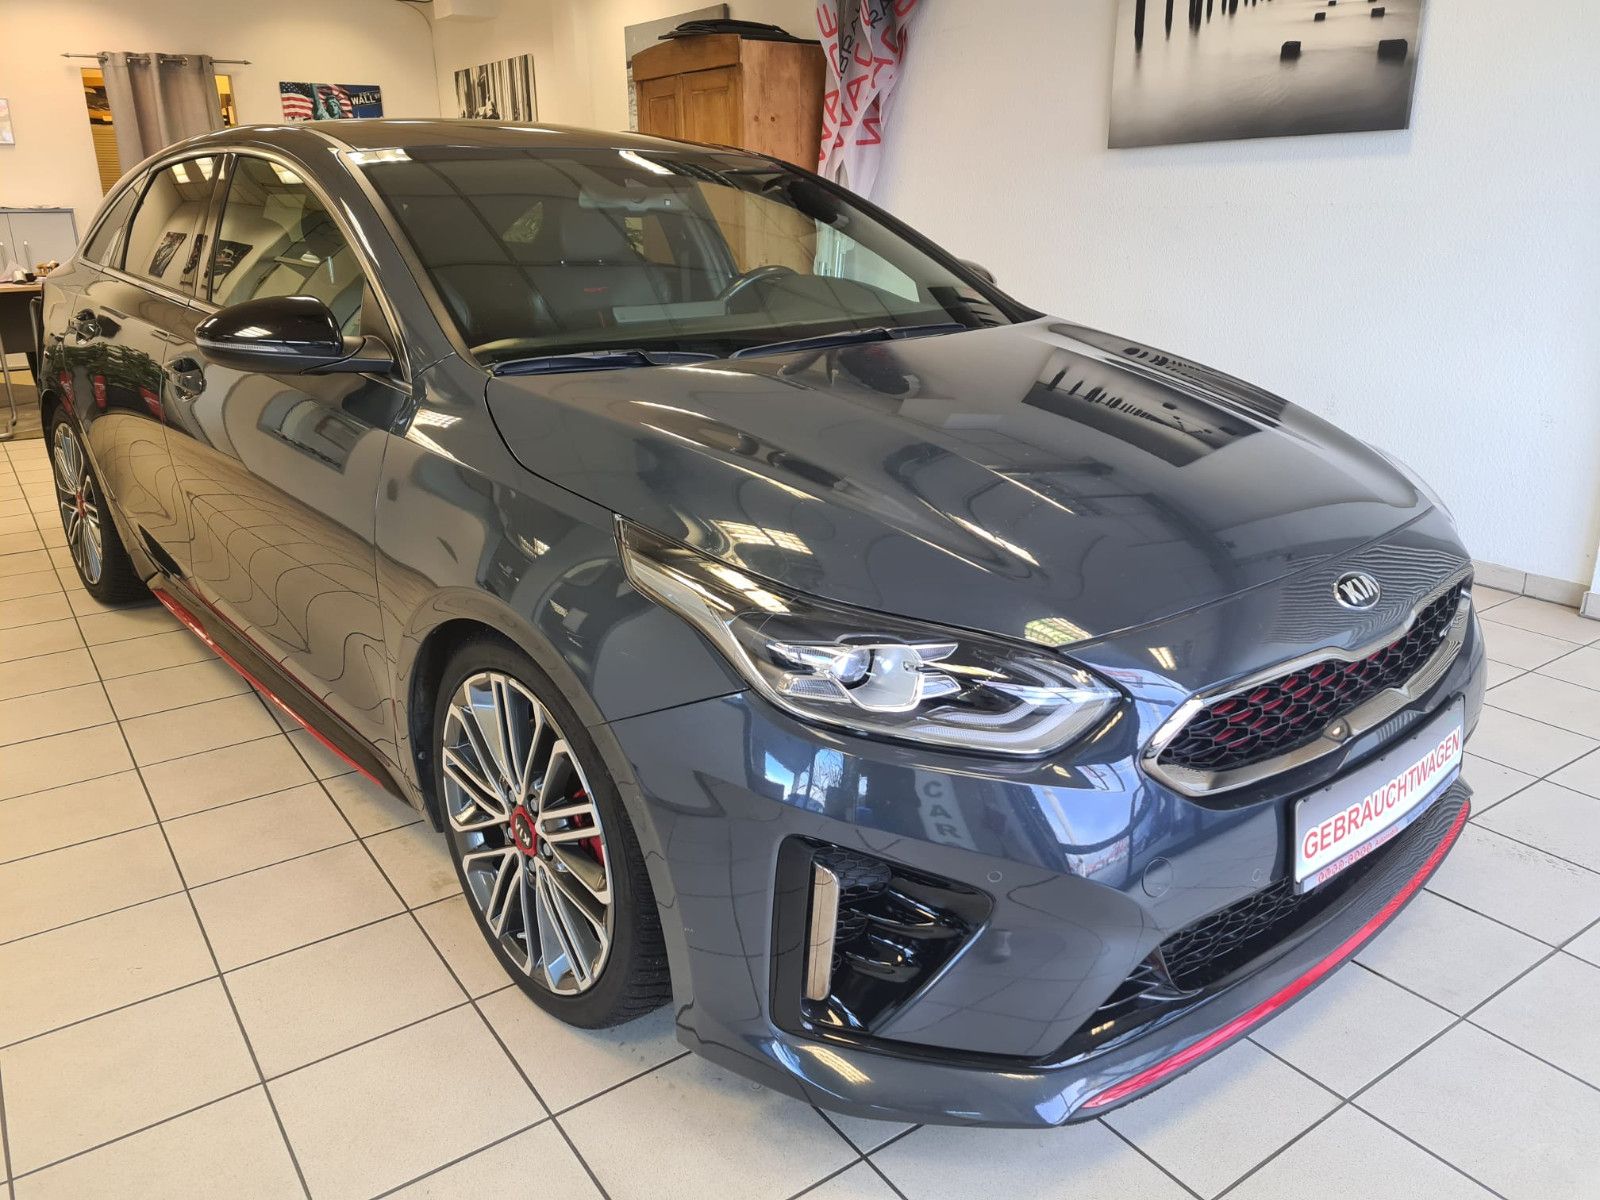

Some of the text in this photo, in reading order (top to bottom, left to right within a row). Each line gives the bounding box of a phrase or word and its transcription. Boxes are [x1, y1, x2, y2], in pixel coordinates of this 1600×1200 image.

[350, 93, 376, 105] WALL
[1339, 575, 1379, 605] KIA
[1303, 731, 1461, 859] GEBRAUCHTWAGEN
